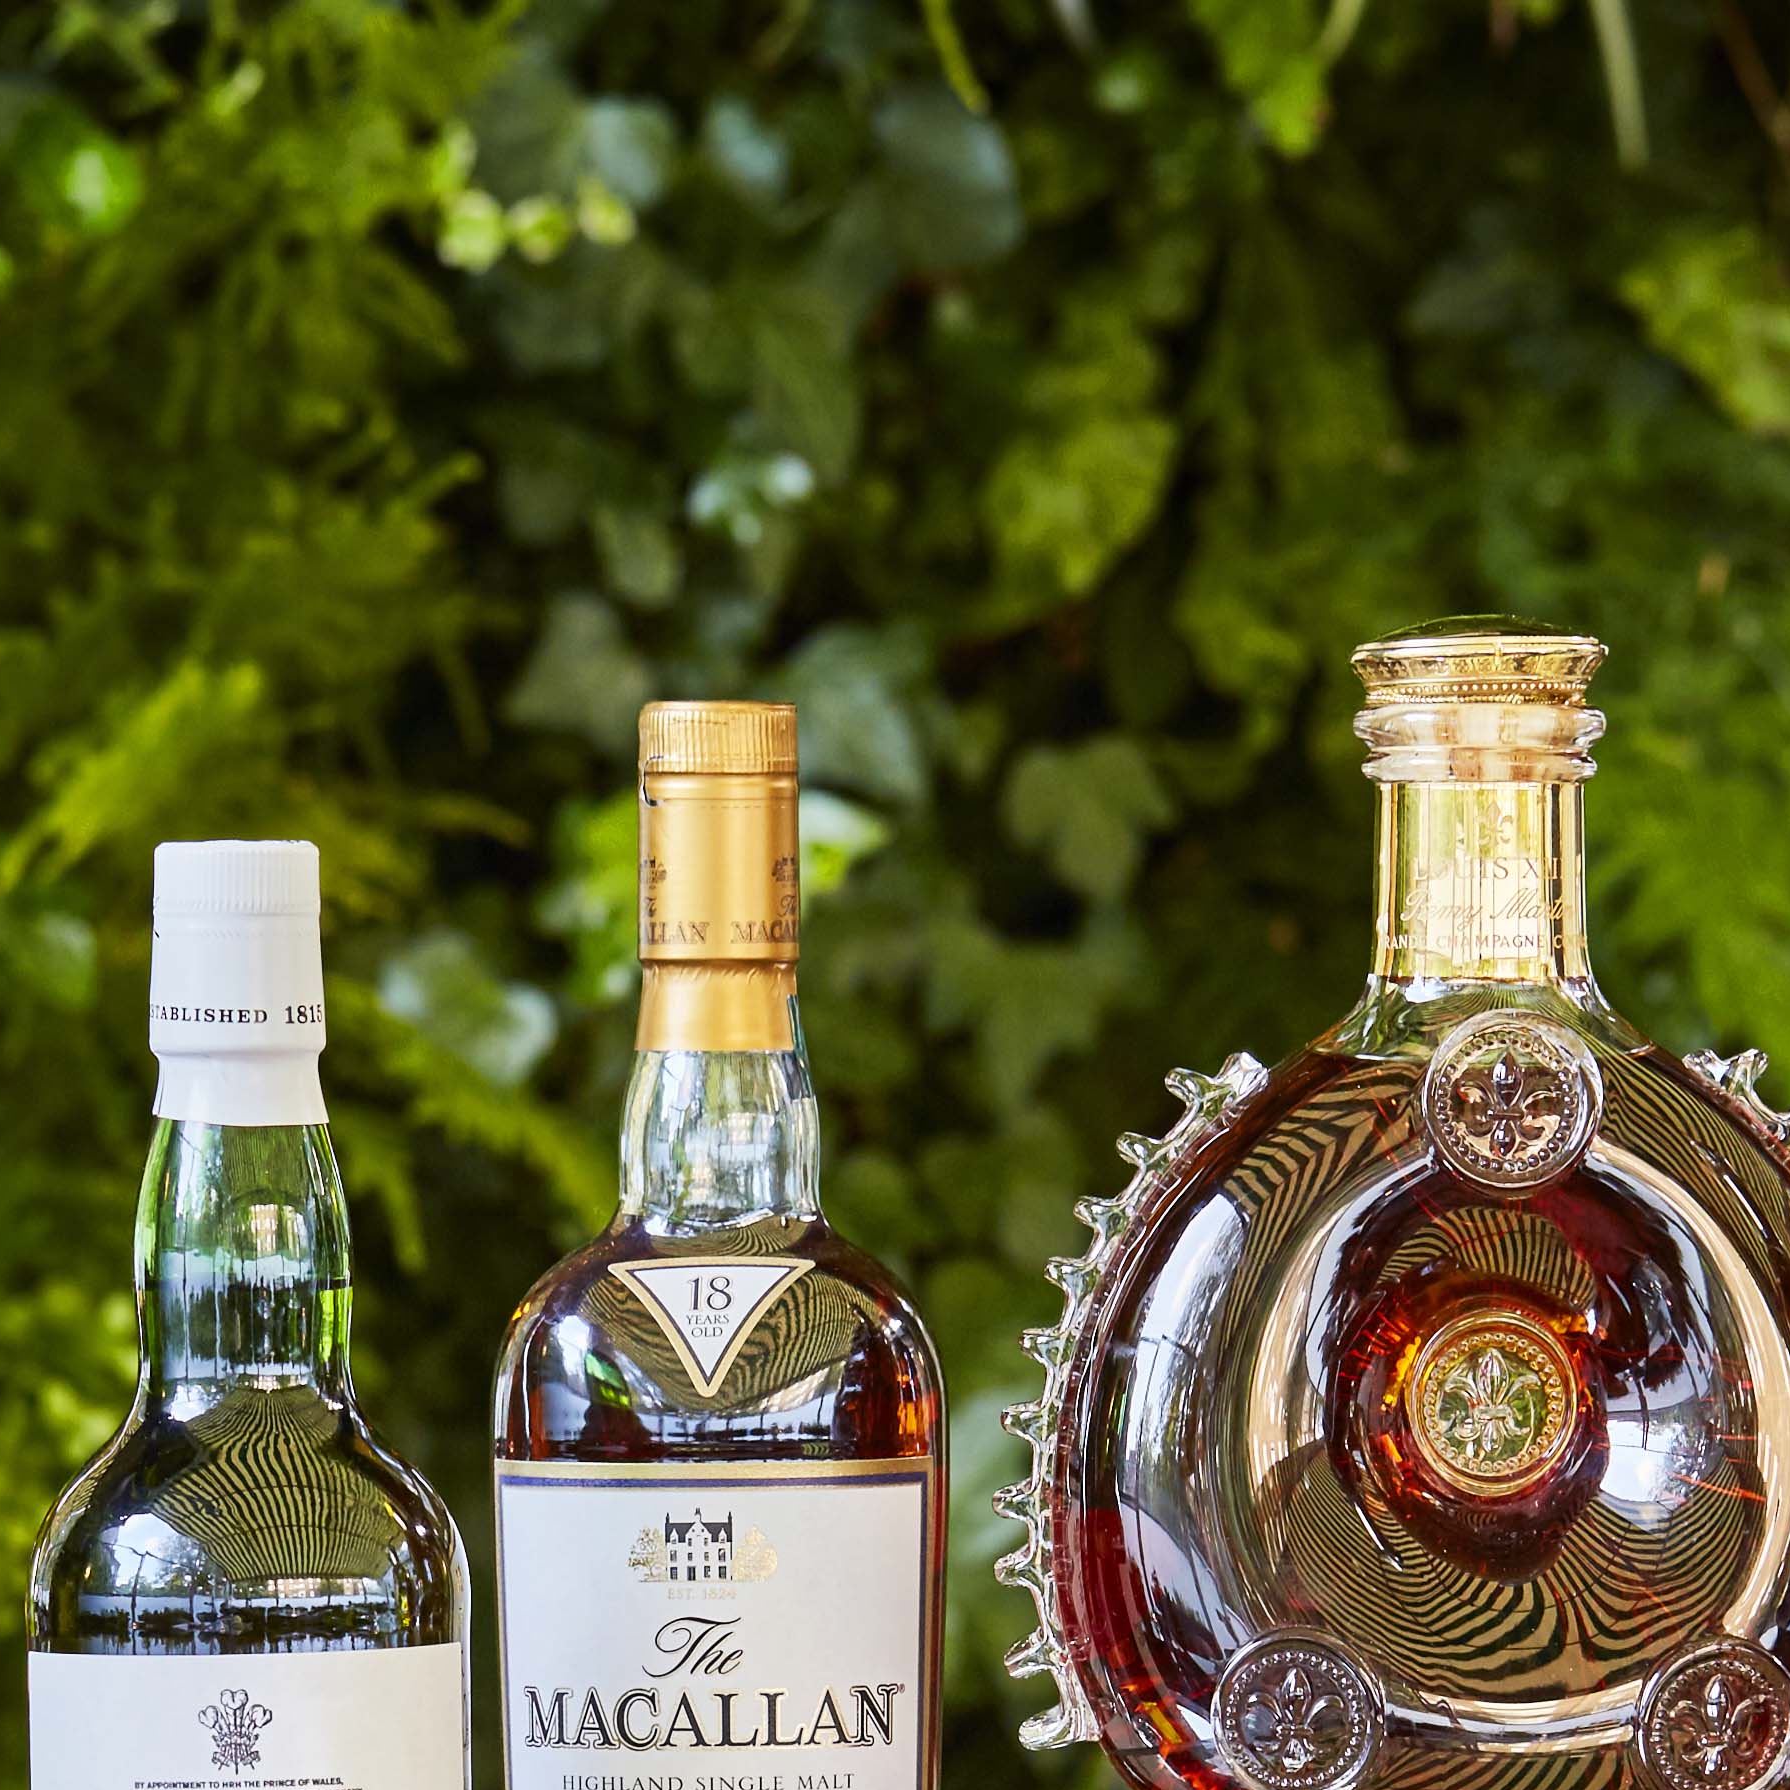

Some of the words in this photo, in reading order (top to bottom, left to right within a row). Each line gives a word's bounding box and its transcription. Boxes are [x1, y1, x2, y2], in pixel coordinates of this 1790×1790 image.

[151, 1004, 267, 1023] STABLISHED
[284, 1003, 323, 1024] 1815
[687, 1275, 734, 1312] 18
[685, 1314, 730, 1325] YEARS
[691, 1327, 723, 1338] OLD
[642, 1615, 744, 1679] The
[147, 1781, 206, 1789] APPOINTMENT
[209, 1781, 220, 1789] TO
[244, 1780, 260, 1788] THE
[263, 1780, 295, 1788] PRINCE
[298, 1778, 309, 1786] OF
[796, 1772, 855, 1790] MALT
